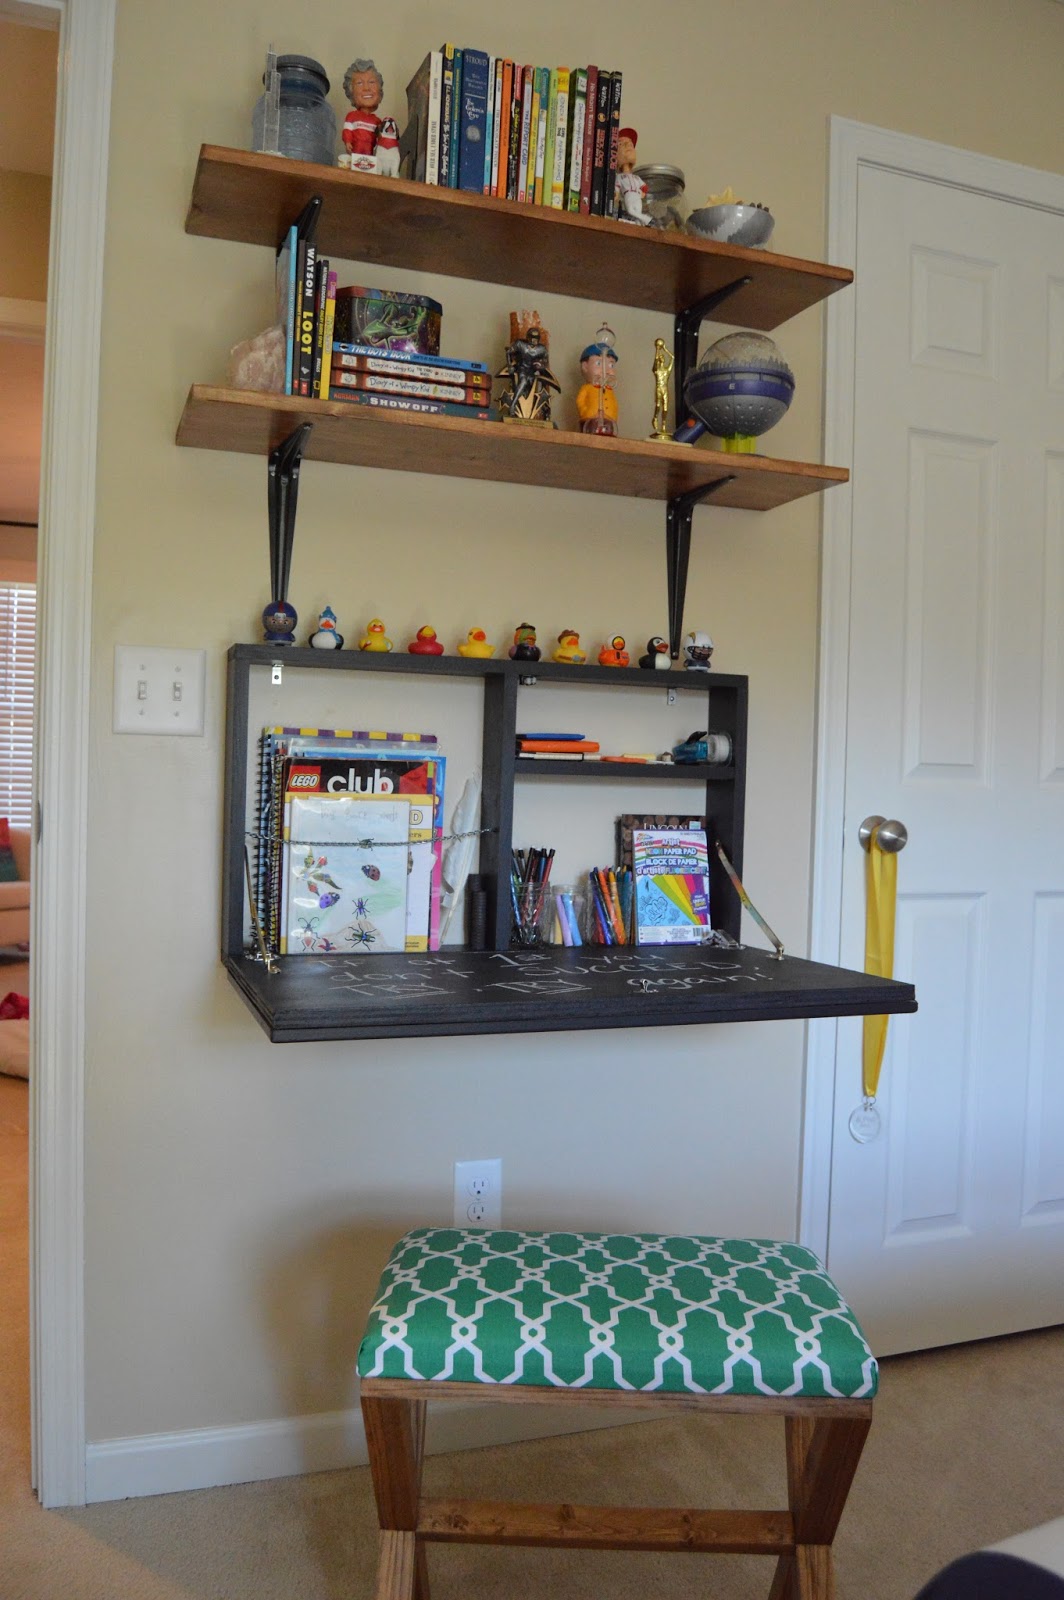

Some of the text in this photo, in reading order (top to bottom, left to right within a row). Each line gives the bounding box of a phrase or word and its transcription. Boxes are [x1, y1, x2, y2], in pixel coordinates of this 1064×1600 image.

[609, 126, 619, 170] STICK DOG
[305, 247, 314, 296] WATSON
[301, 311, 313, 354] LOOT
[370, 377, 388, 387] Diary
[400, 382, 420, 392] Wimpy
[420, 384, 430, 393] Kid
[290, 774, 319, 787] LEGO
[327, 768, 394, 794] club
[663, 847, 683, 855] PAPER
[683, 847, 697, 855] PAD
